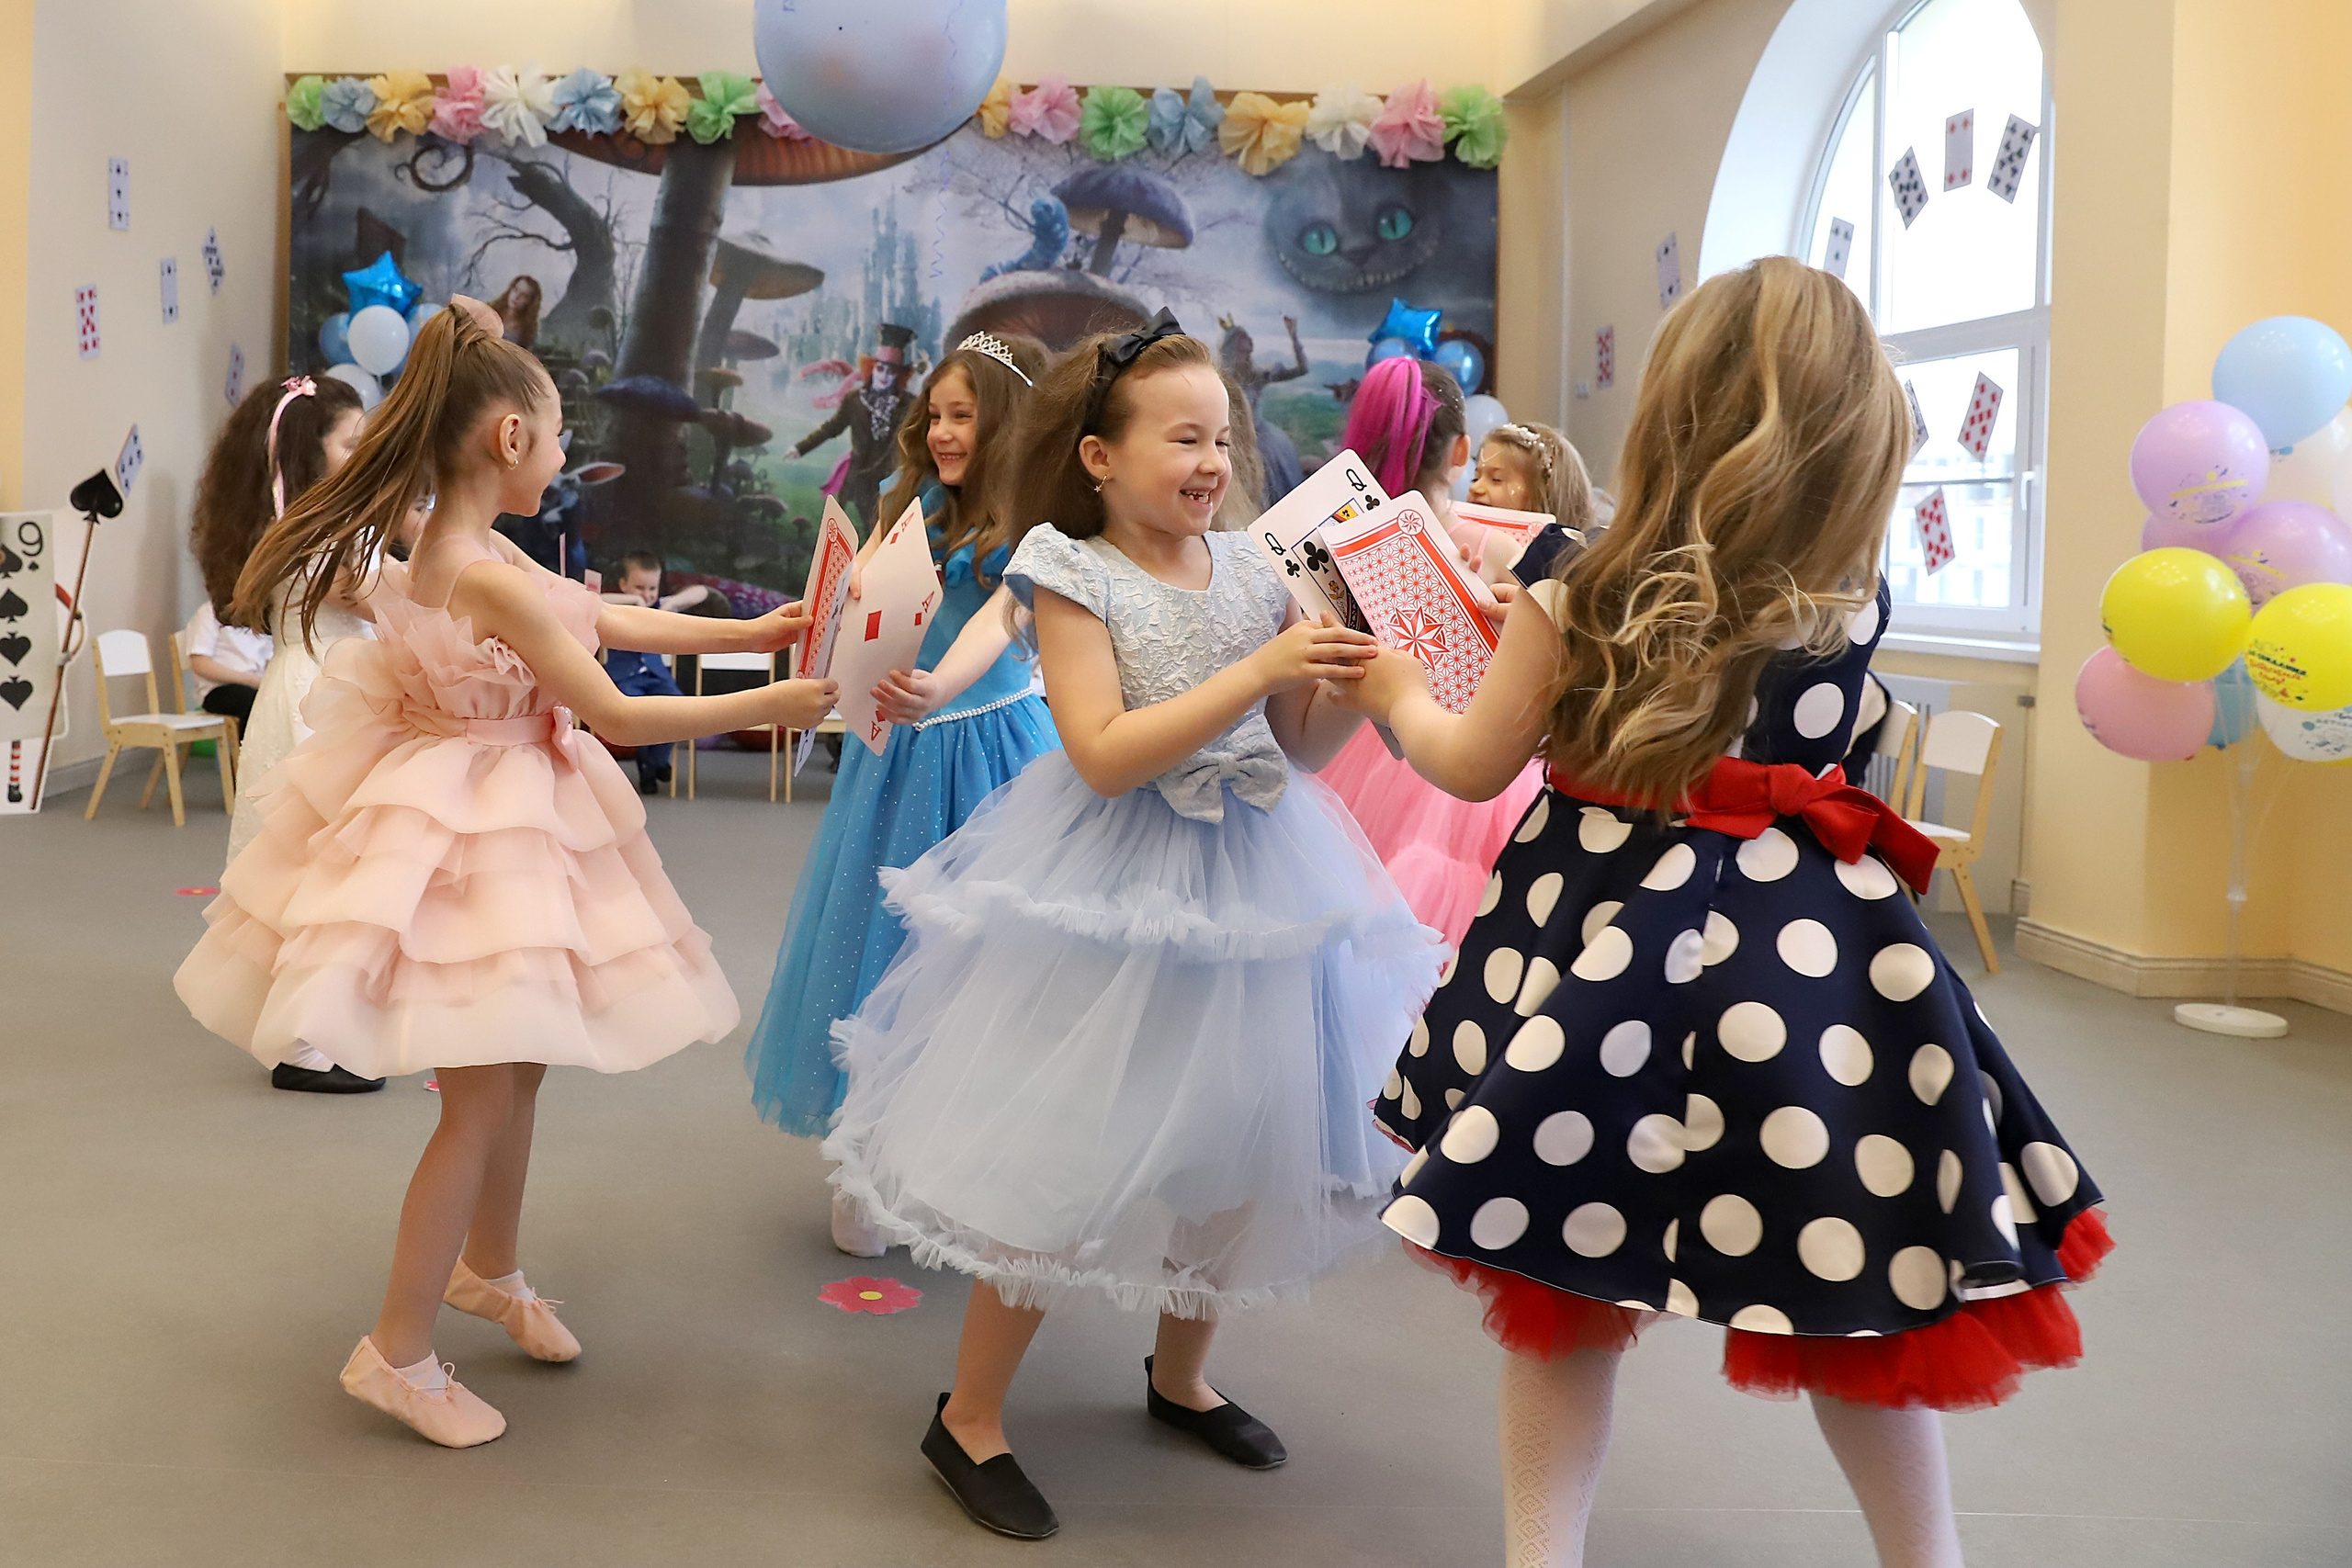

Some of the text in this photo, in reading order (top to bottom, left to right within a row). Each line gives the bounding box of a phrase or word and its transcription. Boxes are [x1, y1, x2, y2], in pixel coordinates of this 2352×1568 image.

[1346, 468, 1367, 491] Q
[901, 512, 915, 533] A
[17, 522, 44, 557] 9
[1265, 532, 1287, 556] Q
[922, 591, 935, 614] A
[870, 720, 883, 741] A
